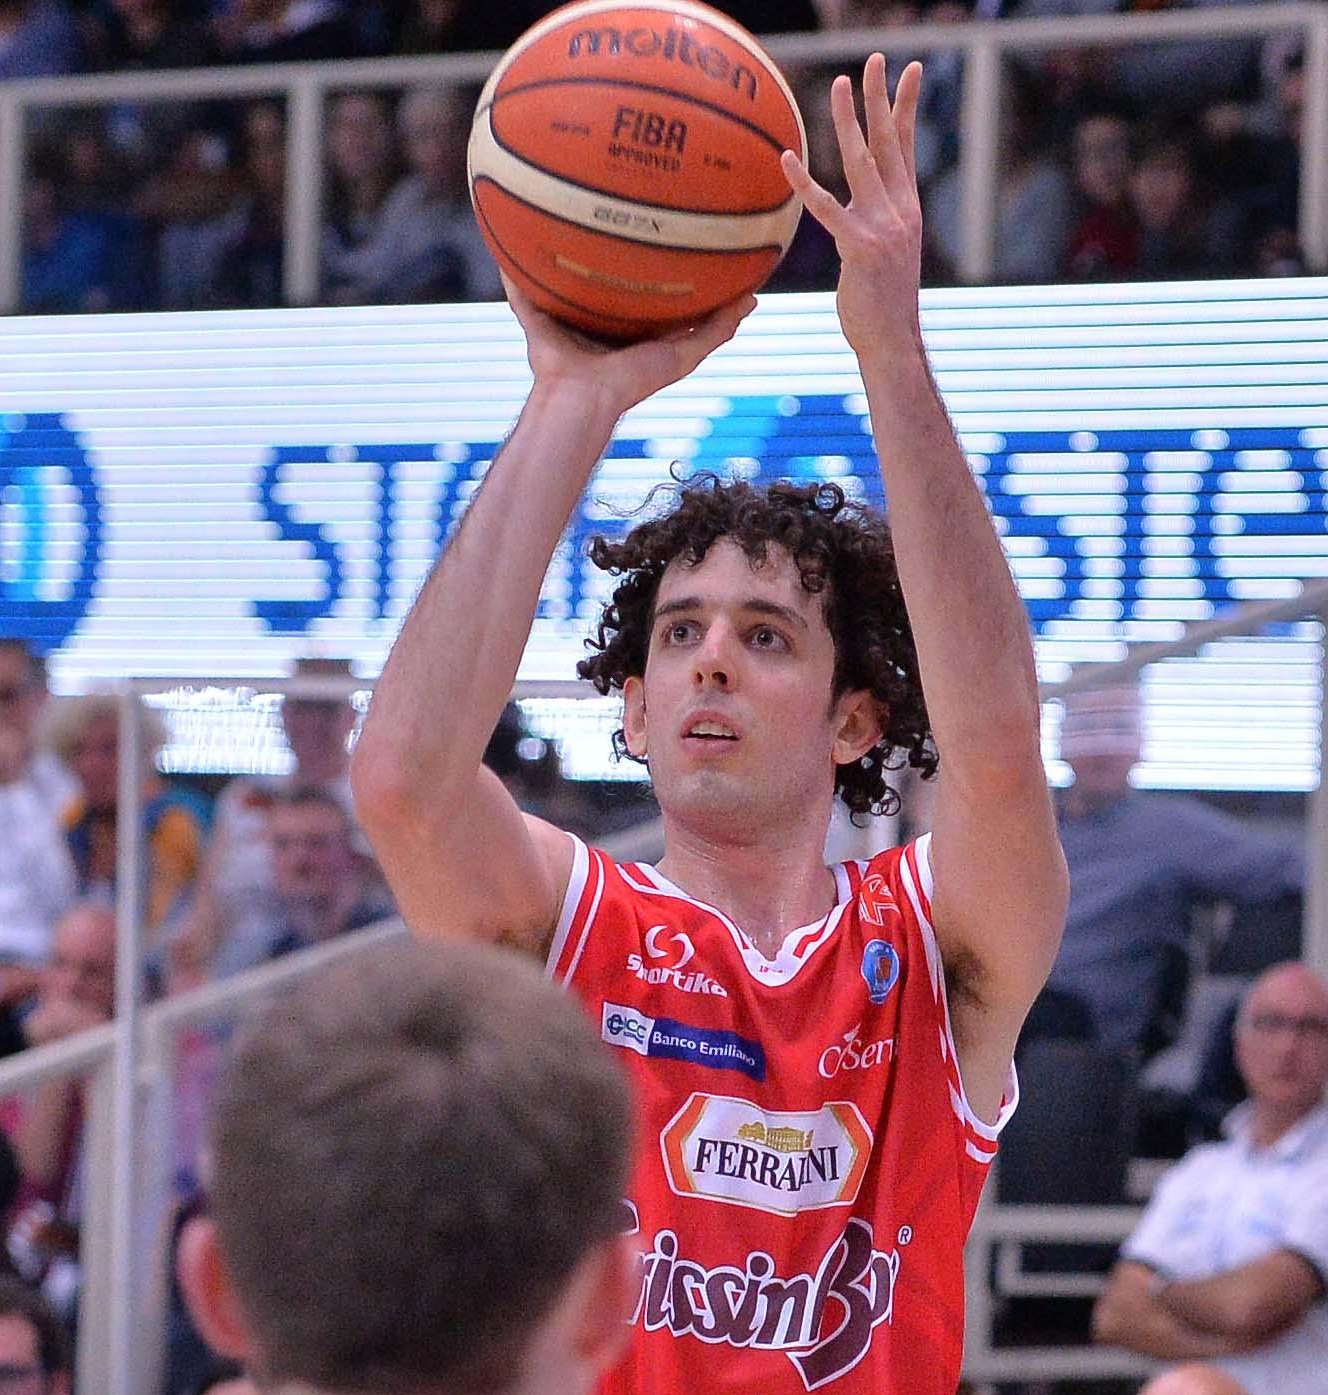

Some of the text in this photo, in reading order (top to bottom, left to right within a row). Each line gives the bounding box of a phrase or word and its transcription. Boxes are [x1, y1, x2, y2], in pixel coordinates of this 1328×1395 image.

[568, 25, 760, 101] molten
[612, 105, 688, 156] FIBA
[652, 1031, 697, 1050] Banco
[699, 1041, 756, 1067] Emiliano
